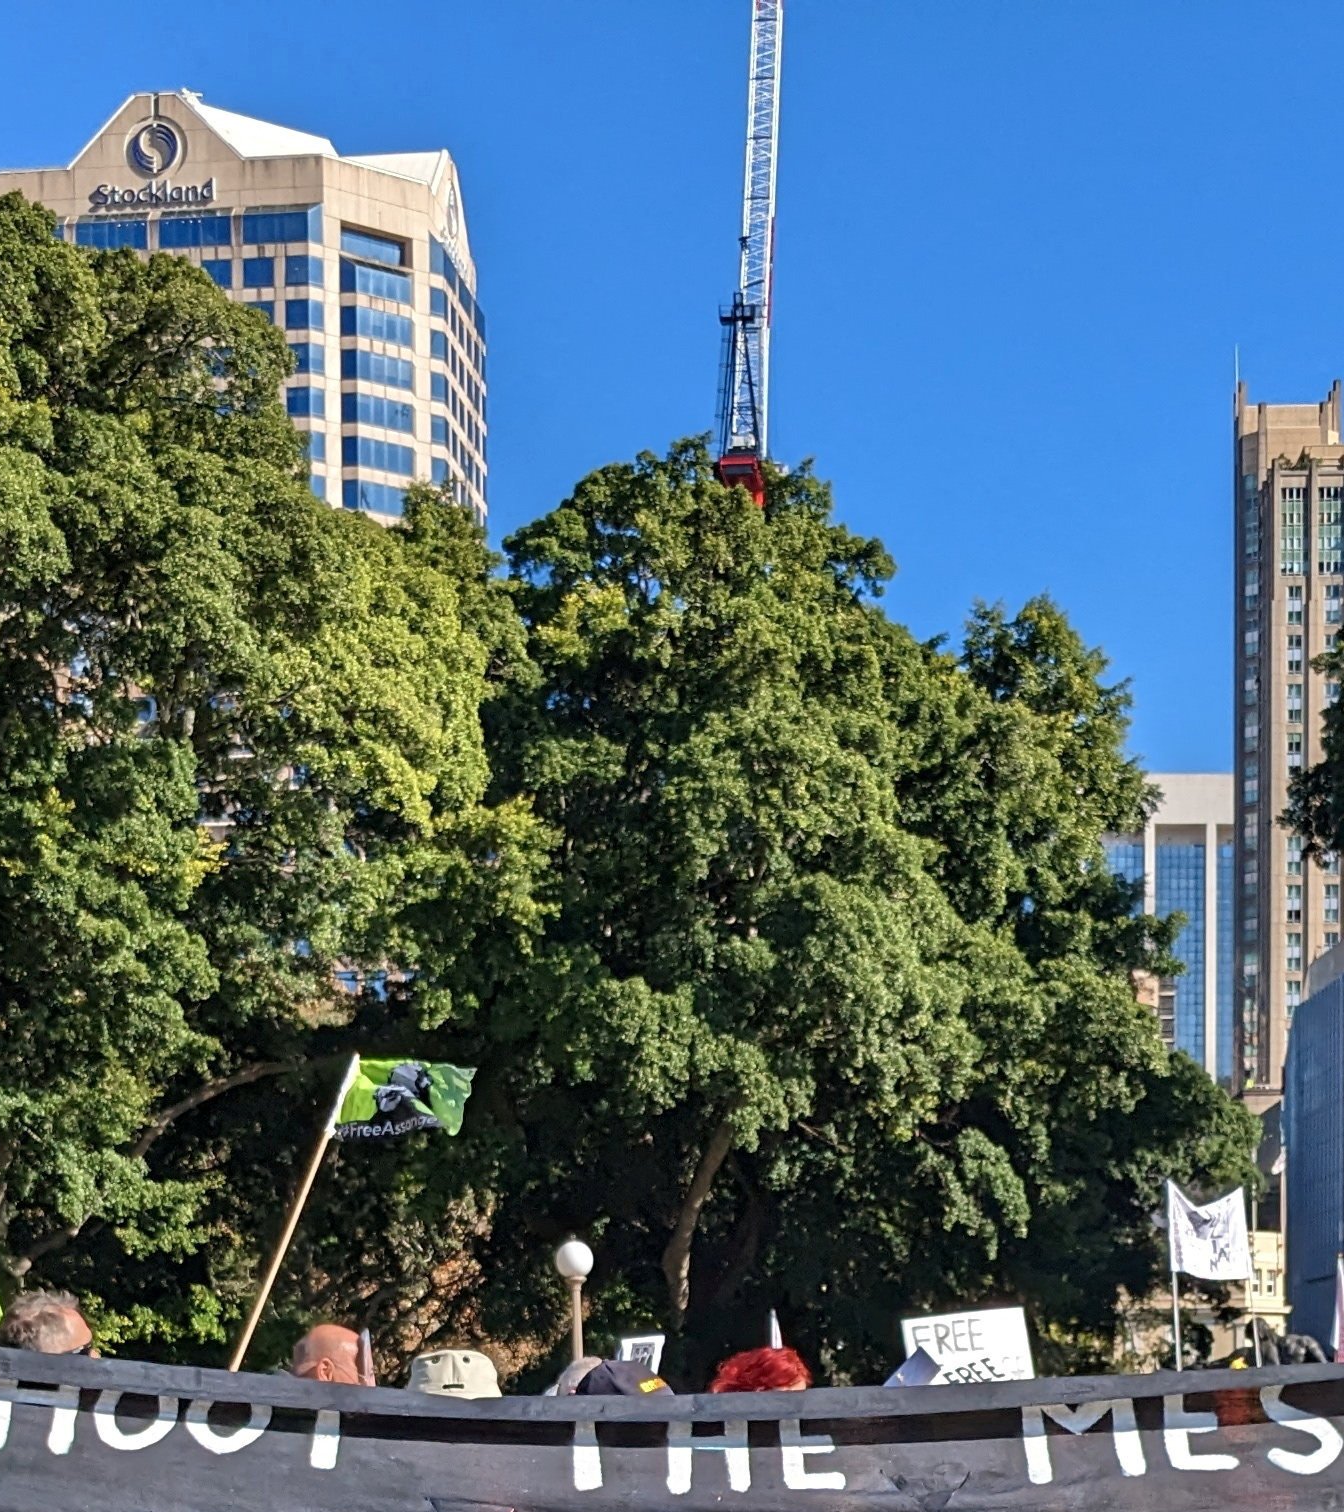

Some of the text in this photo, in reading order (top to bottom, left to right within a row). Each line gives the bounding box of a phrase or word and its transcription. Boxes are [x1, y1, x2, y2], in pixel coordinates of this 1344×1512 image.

[96, 177, 217, 205] Stockland
[911, 1318, 984, 1355] FREE
[942, 1357, 1005, 1384] FREE
